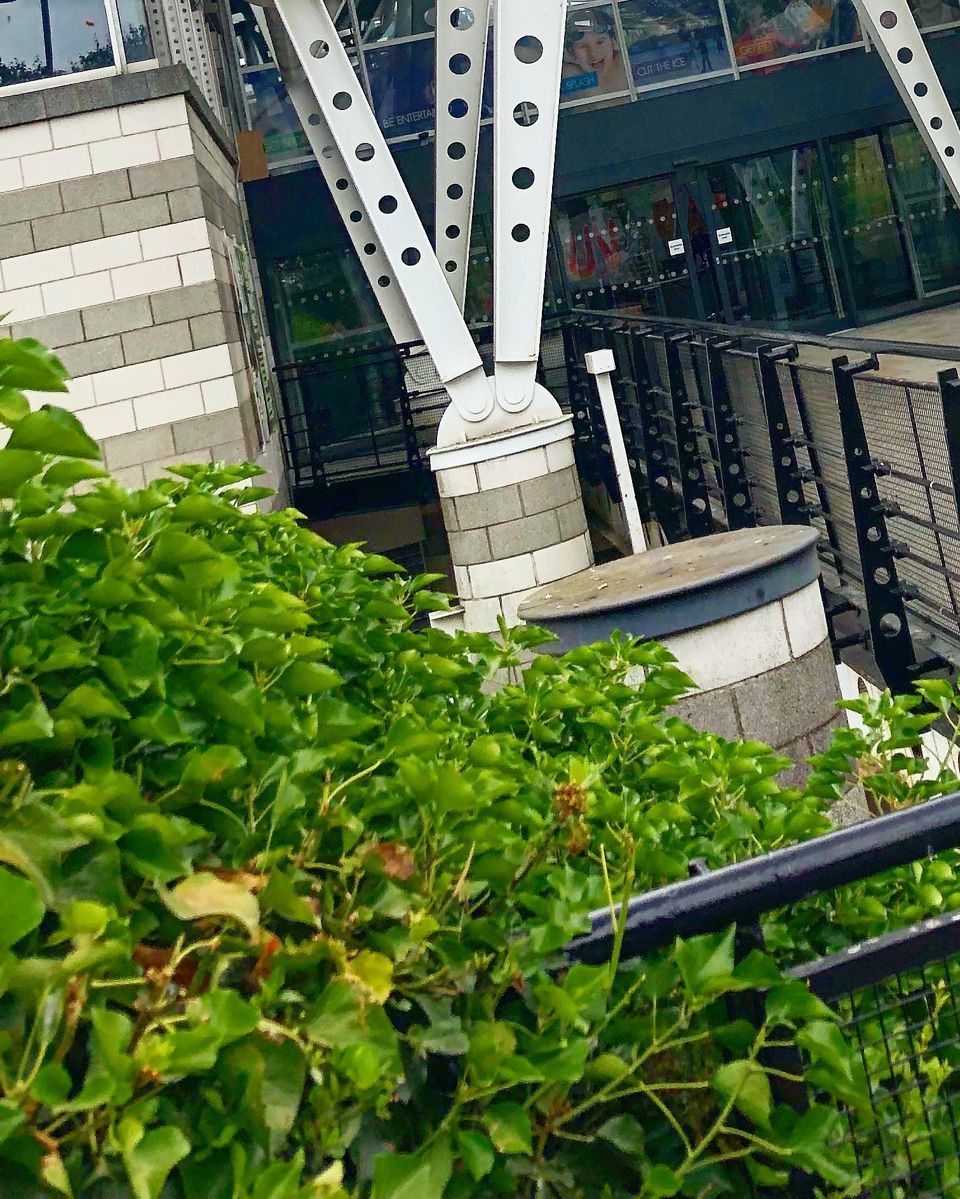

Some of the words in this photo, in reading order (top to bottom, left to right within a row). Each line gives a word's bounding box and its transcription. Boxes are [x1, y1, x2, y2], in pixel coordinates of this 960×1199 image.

[637, 64, 654, 77] CUT
[655, 60, 672, 72] THE
[672, 57, 687, 68] ICE
[383, 117, 395, 129] BE
[396, 109, 435, 126] ENTERTA
